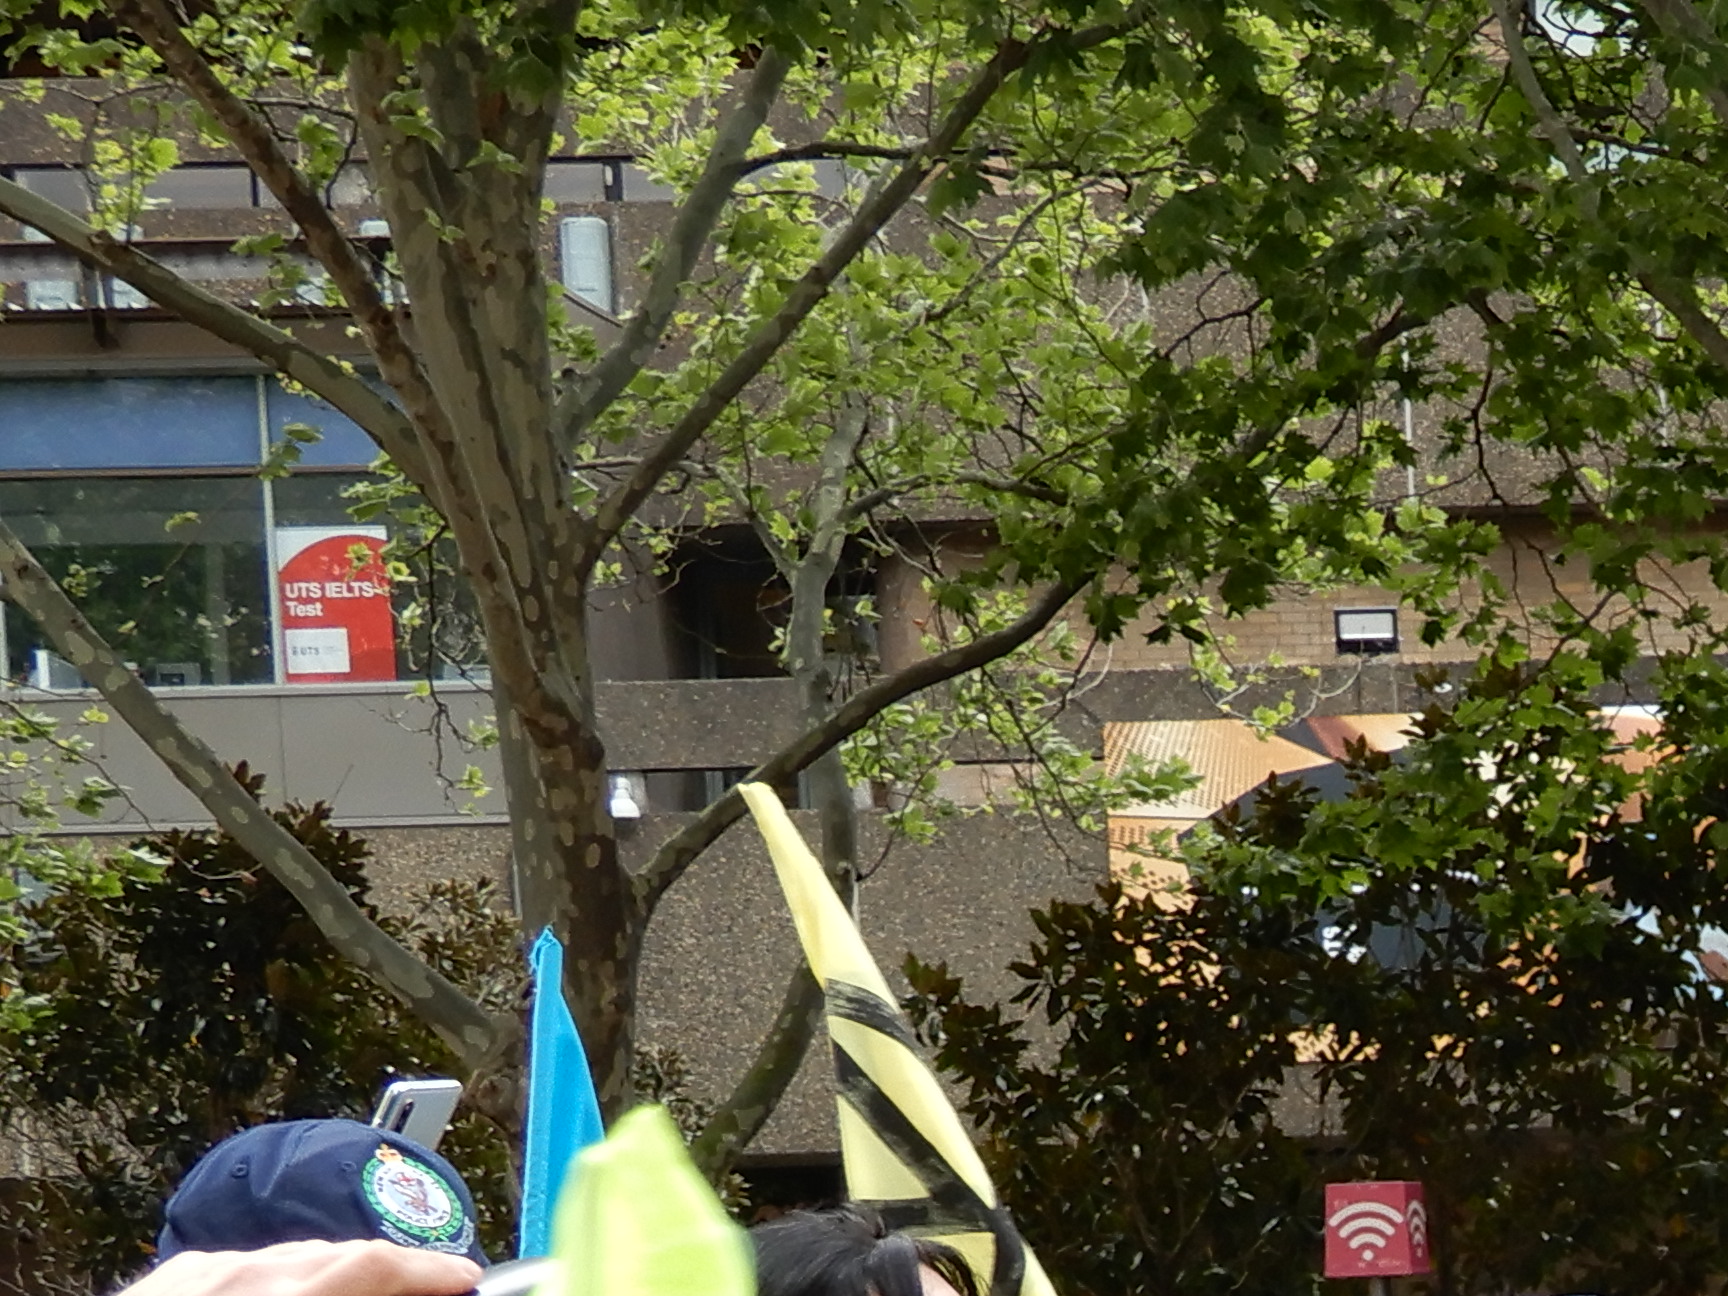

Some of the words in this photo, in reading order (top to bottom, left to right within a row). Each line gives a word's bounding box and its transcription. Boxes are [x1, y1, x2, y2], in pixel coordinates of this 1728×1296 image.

[285, 581, 322, 599] UTS
[324, 581, 375, 599] IELTS
[285, 601, 323, 617] Test
